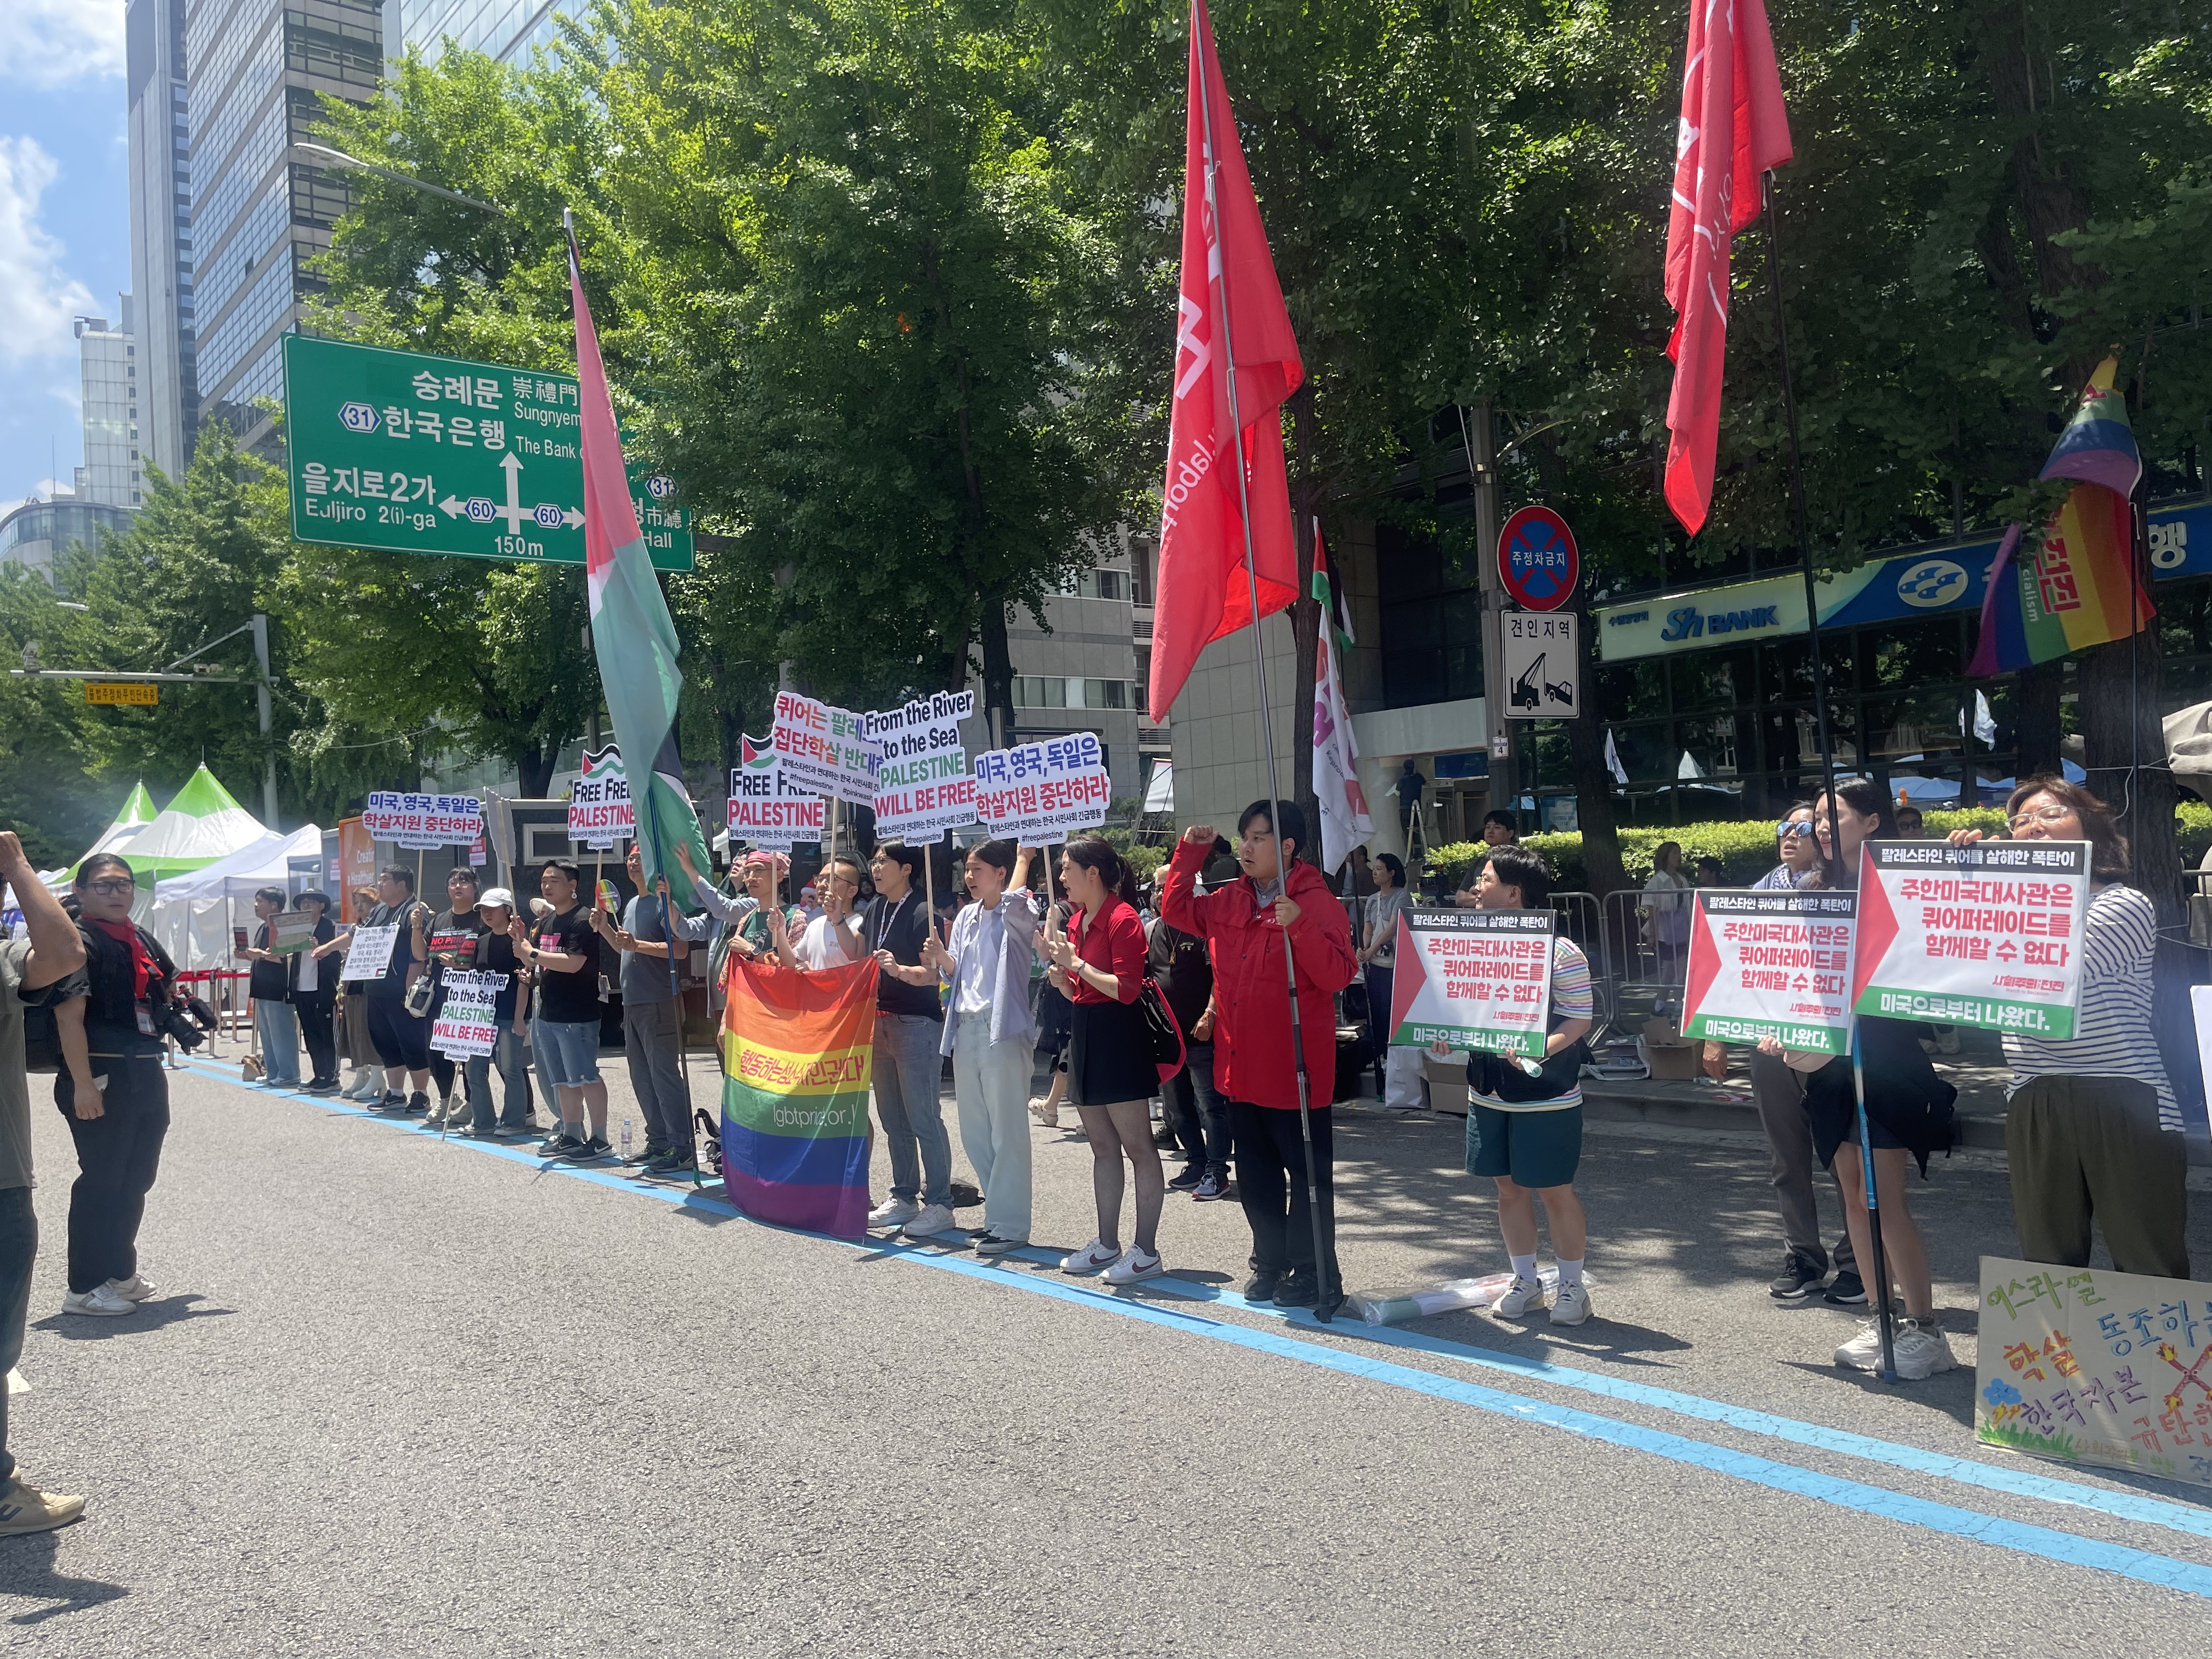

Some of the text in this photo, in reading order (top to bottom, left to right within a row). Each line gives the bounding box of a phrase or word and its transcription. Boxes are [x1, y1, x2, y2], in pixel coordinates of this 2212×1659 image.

[412, 370, 503, 410] 숭례문
[513, 376, 578, 407] 崇禮門
[348, 407, 370, 426] 31
[514, 401, 581, 428] Sungnyem
[383, 405, 505, 450] 한국은행
[516, 435, 540, 455] The
[544, 439, 576, 459] Bank
[301, 462, 437, 506] 을지로2가
[654, 478, 670, 496] 31
[379, 505, 437, 532] 2(i)-ga
[471, 501, 490, 520] 60
[540, 507, 558, 525] 60
[494, 536, 544, 557] 150m
[1512, 551, 1566, 567] 주정차금지
[2022, 569, 2039, 623] cialism
[1511, 618, 1570, 640] 견인지역
[1660, 605, 1780, 641] Sh BANK
[777, 695, 828, 731] 퀴어는
[866, 692, 973, 735] From the River
[774, 726, 842, 766] 집단학살
[883, 727, 958, 760] to the Sea
[1498, 746, 1503, 754] 4
[781, 758, 817, 775] 팔레스타인과
[817, 768, 840, 781] 연대하는
[840, 774, 851, 785] 한국
[851, 777, 873, 789] 시민사회
[789, 772, 833, 791] #freepalestine
[881, 752, 964, 789] PALESTINE
[573, 781, 601, 803] FREE
[732, 770, 771, 796] FREE
[842, 786, 873, 801] #pinkwash
[874, 780, 976, 818] WILL BE FREE
[975, 772, 1108, 820] 학살지원 중단하라
[364, 812, 482, 834] 학살지원 중단하라
[568, 804, 635, 828] PALESTINE
[729, 799, 823, 827] PALESTINE
[878, 811, 975, 836] 팔레스타인과 연대하는 한국 시민사회 긴급행동
[990, 809, 1102, 834] 팔레스타인과 연대하는 한국 시민사회 긴급행동
[730, 830, 819, 840] 팔레스타인과 연대하는 한국 시민사회 긴급행동
[758, 843, 791, 851] #freepalestine
[905, 833, 942, 845] #freepalestine
[1022, 830, 1063, 843] #freepalestine
[1882, 848, 2075, 867] 팔레스타인 퀴어를 살해한 폭탄이
[1709, 896, 1852, 912] 팔레스타인 퀴어를 살해한 폭탄이
[1900, 878, 2073, 908] 주한미국대사관은
[1413, 914, 1548, 929] 팔레스타인 퀴어를 살해한 폭탄이
[1922, 907, 2072, 938] 퀴어퍼레이드를
[431, 937, 444, 945] NO
[1723, 922, 1849, 946] 주한미국대사관은
[1427, 938, 1546, 959] 주한미국대사관은
[1739, 946, 1847, 971] 퀴어퍼레이드를
[1926, 934, 2070, 967] 함께할 수 없다
[442, 969, 508, 987] From the River
[1443, 960, 1544, 981] 퀴어퍼레이드를
[1741, 969, 1846, 996] 함께할 수 없다
[449, 988, 494, 1005] to the Sea
[1446, 980, 1543, 1003] 함께할 수 없다
[441, 1005, 494, 1024] PALESTINE
[1880, 993, 2050, 1031] 미국으로부터 나왔다.
[433, 1023, 498, 1043] WILL BE FREE
[1413, 1027, 1530, 1052] 미국으로부터 나왔다.
[1705, 1020, 1830, 1049] 미국으로부터 나왔다.
[2003, 1329, 2084, 1383] 학살
